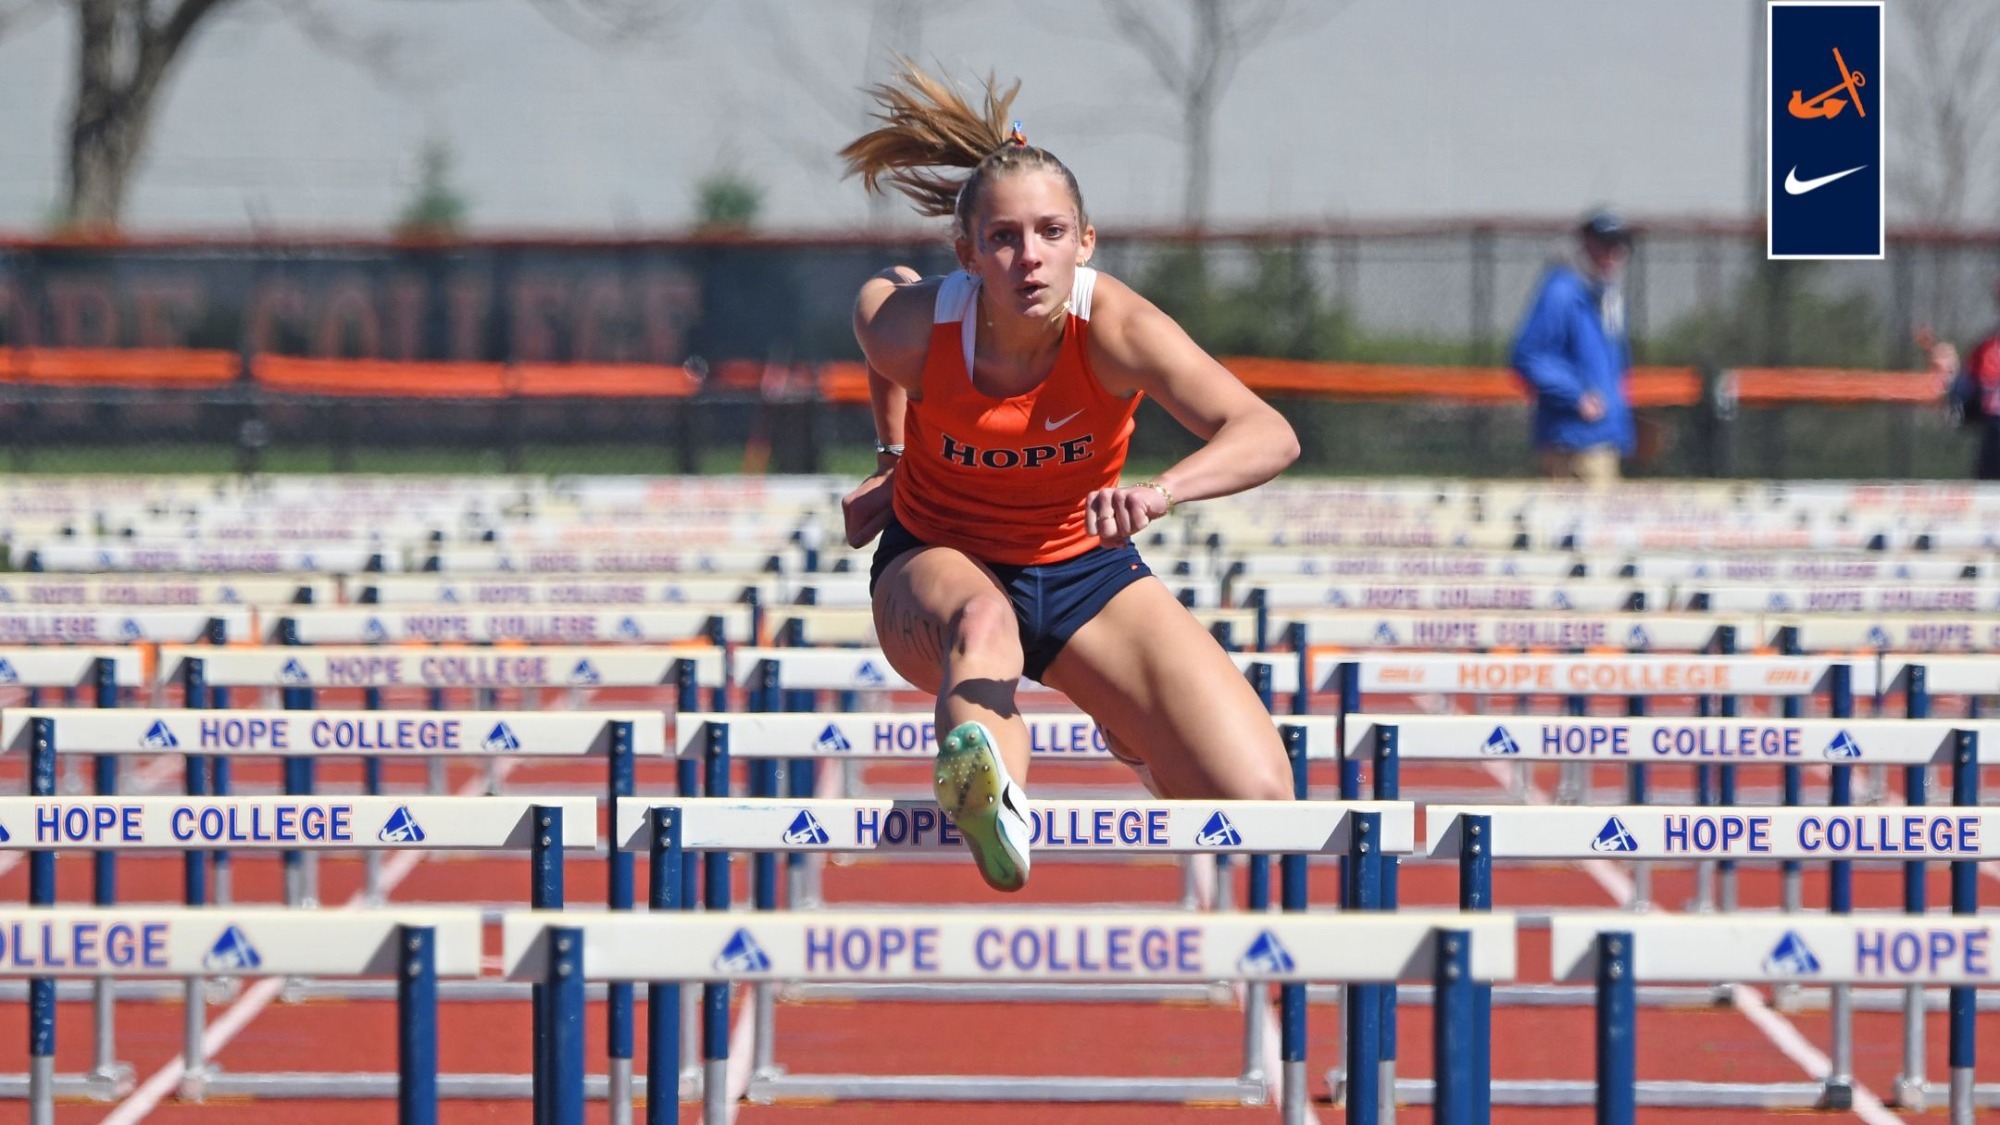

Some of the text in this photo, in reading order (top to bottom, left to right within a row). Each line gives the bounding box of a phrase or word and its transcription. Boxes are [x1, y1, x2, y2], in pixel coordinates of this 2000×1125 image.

[941, 433, 1094, 469] HOPE
[326, 657, 549, 684] HOPE COLLEGE
[1458, 663, 1731, 689] HOPE COLLEGE
[201, 719, 460, 748] HOPE COLLEGE
[874, 723, 1107, 751] HOP LLEG
[1542, 726, 1802, 756] HOPE COLLEGE
[35, 805, 353, 842] HOPE COLLEGE
[855, 808, 1170, 846] HOPE OLLEGE
[1664, 815, 1981, 853] HOPE COLLEGE
[0, 922, 170, 970] LLEGE
[805, 928, 1206, 971] HOPE COLLEGE
[1855, 928, 1992, 976] HOPE
